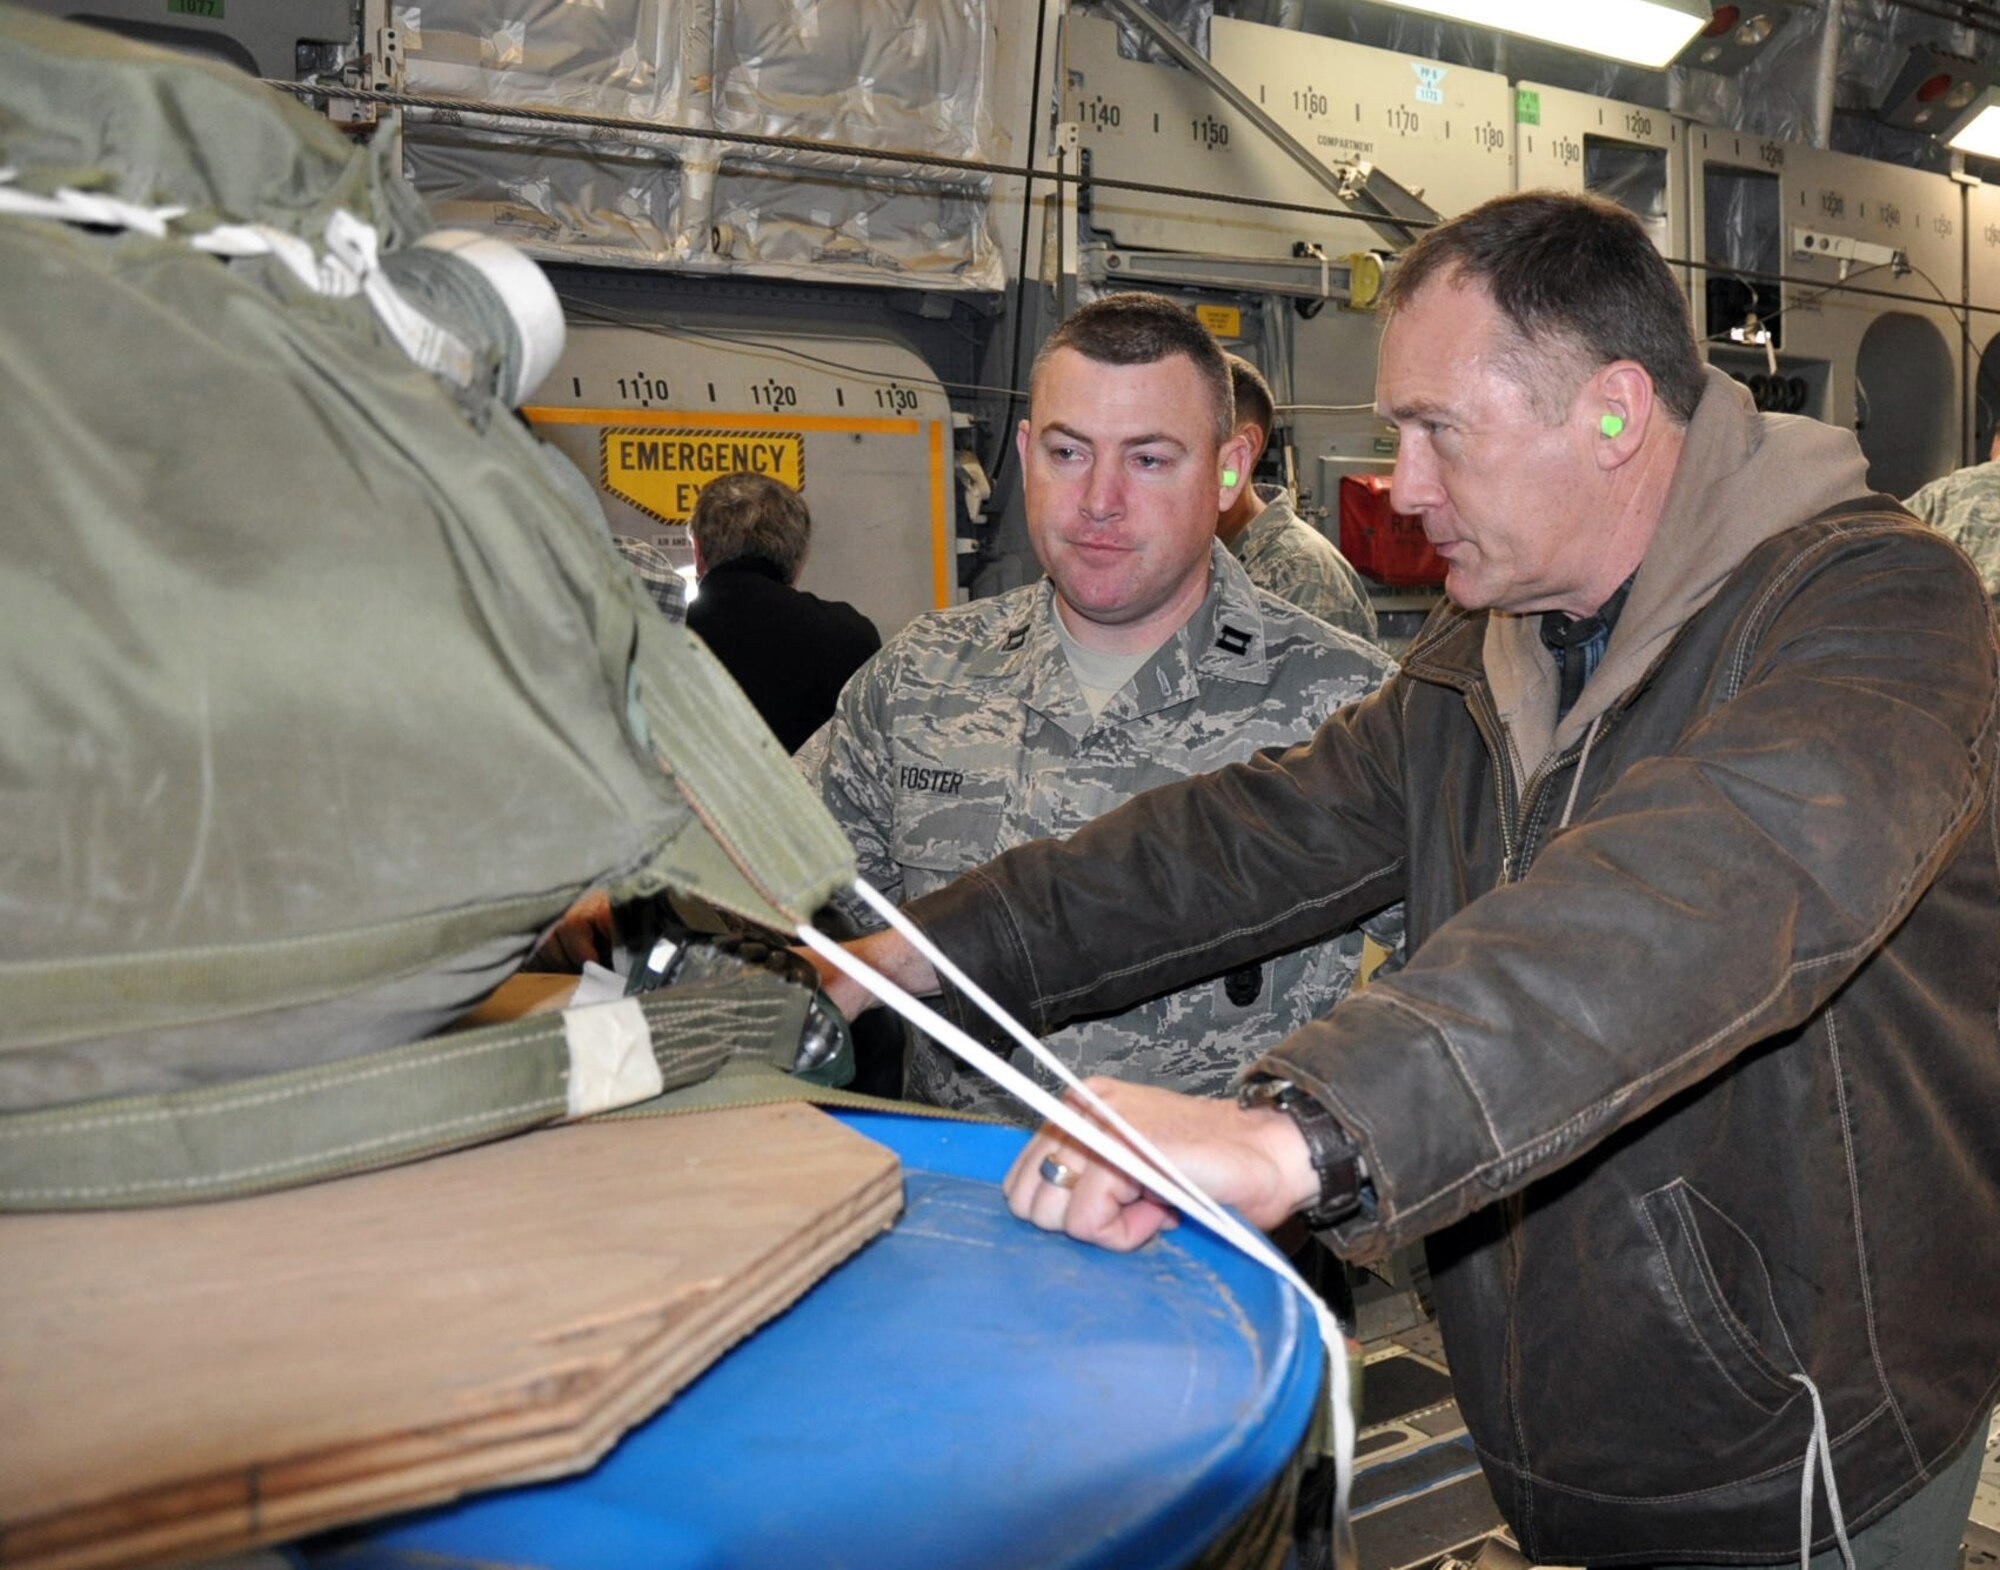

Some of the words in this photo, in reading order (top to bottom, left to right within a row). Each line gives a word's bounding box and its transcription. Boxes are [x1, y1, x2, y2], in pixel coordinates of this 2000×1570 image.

[1078, 100, 1121, 127] 1140
[1191, 120, 1229, 145] 1150
[1292, 91, 1327, 115] 1160
[1387, 109, 1419, 132] 1170
[1474, 126, 1504, 149] 1180
[1551, 141, 1580, 163] 1190
[1625, 113, 1651, 135] 1200
[1316, 134, 1374, 154] COMPARTMENT
[617, 378, 669, 401] 1110
[750, 384, 797, 407] 1120
[875, 389, 918, 411] 1130
[619, 440, 786, 474] EMERGENCY
[672, 537, 687, 546] AND
[900, 765, 964, 795] FOSTER
